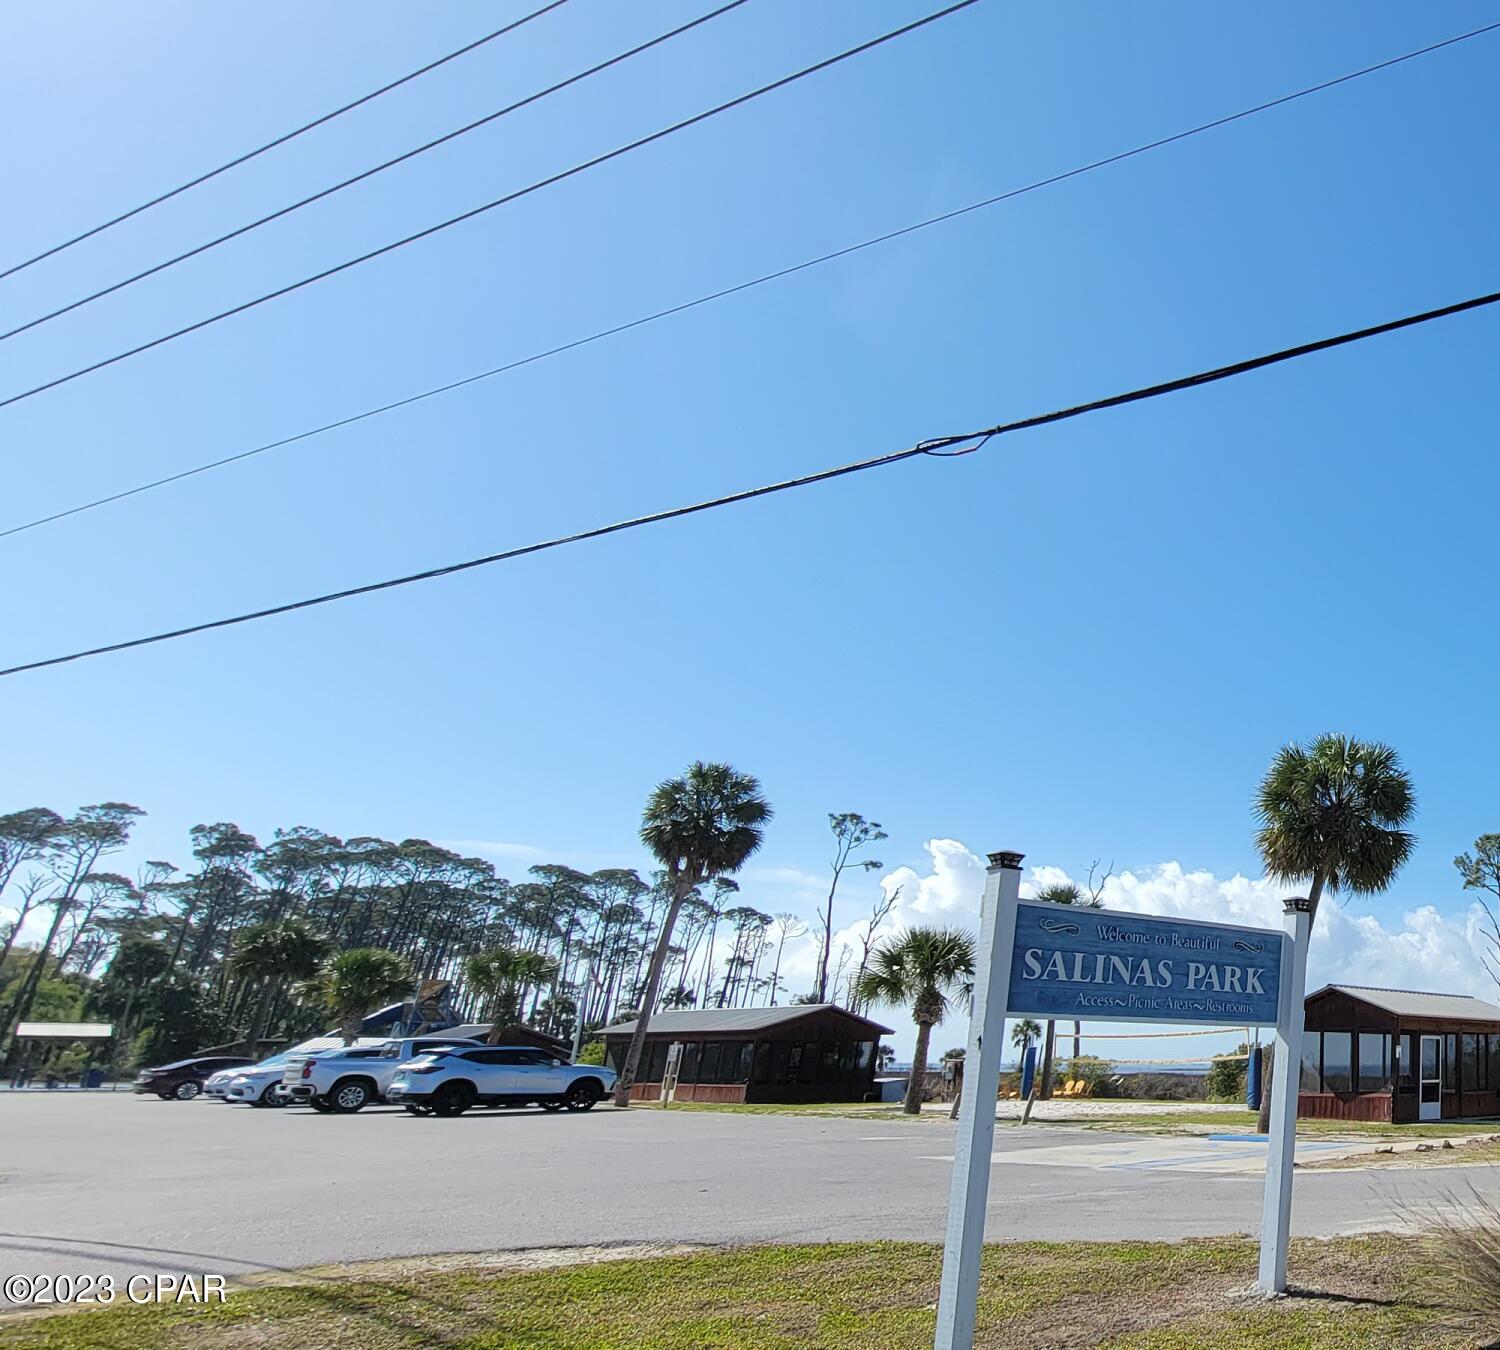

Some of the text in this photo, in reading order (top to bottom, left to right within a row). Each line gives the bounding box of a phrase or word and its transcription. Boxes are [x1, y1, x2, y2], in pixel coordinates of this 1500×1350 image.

[1096, 924, 1220, 950] Welcome to Beautiful
[1022, 948, 1267, 995] SALINAS PARK
